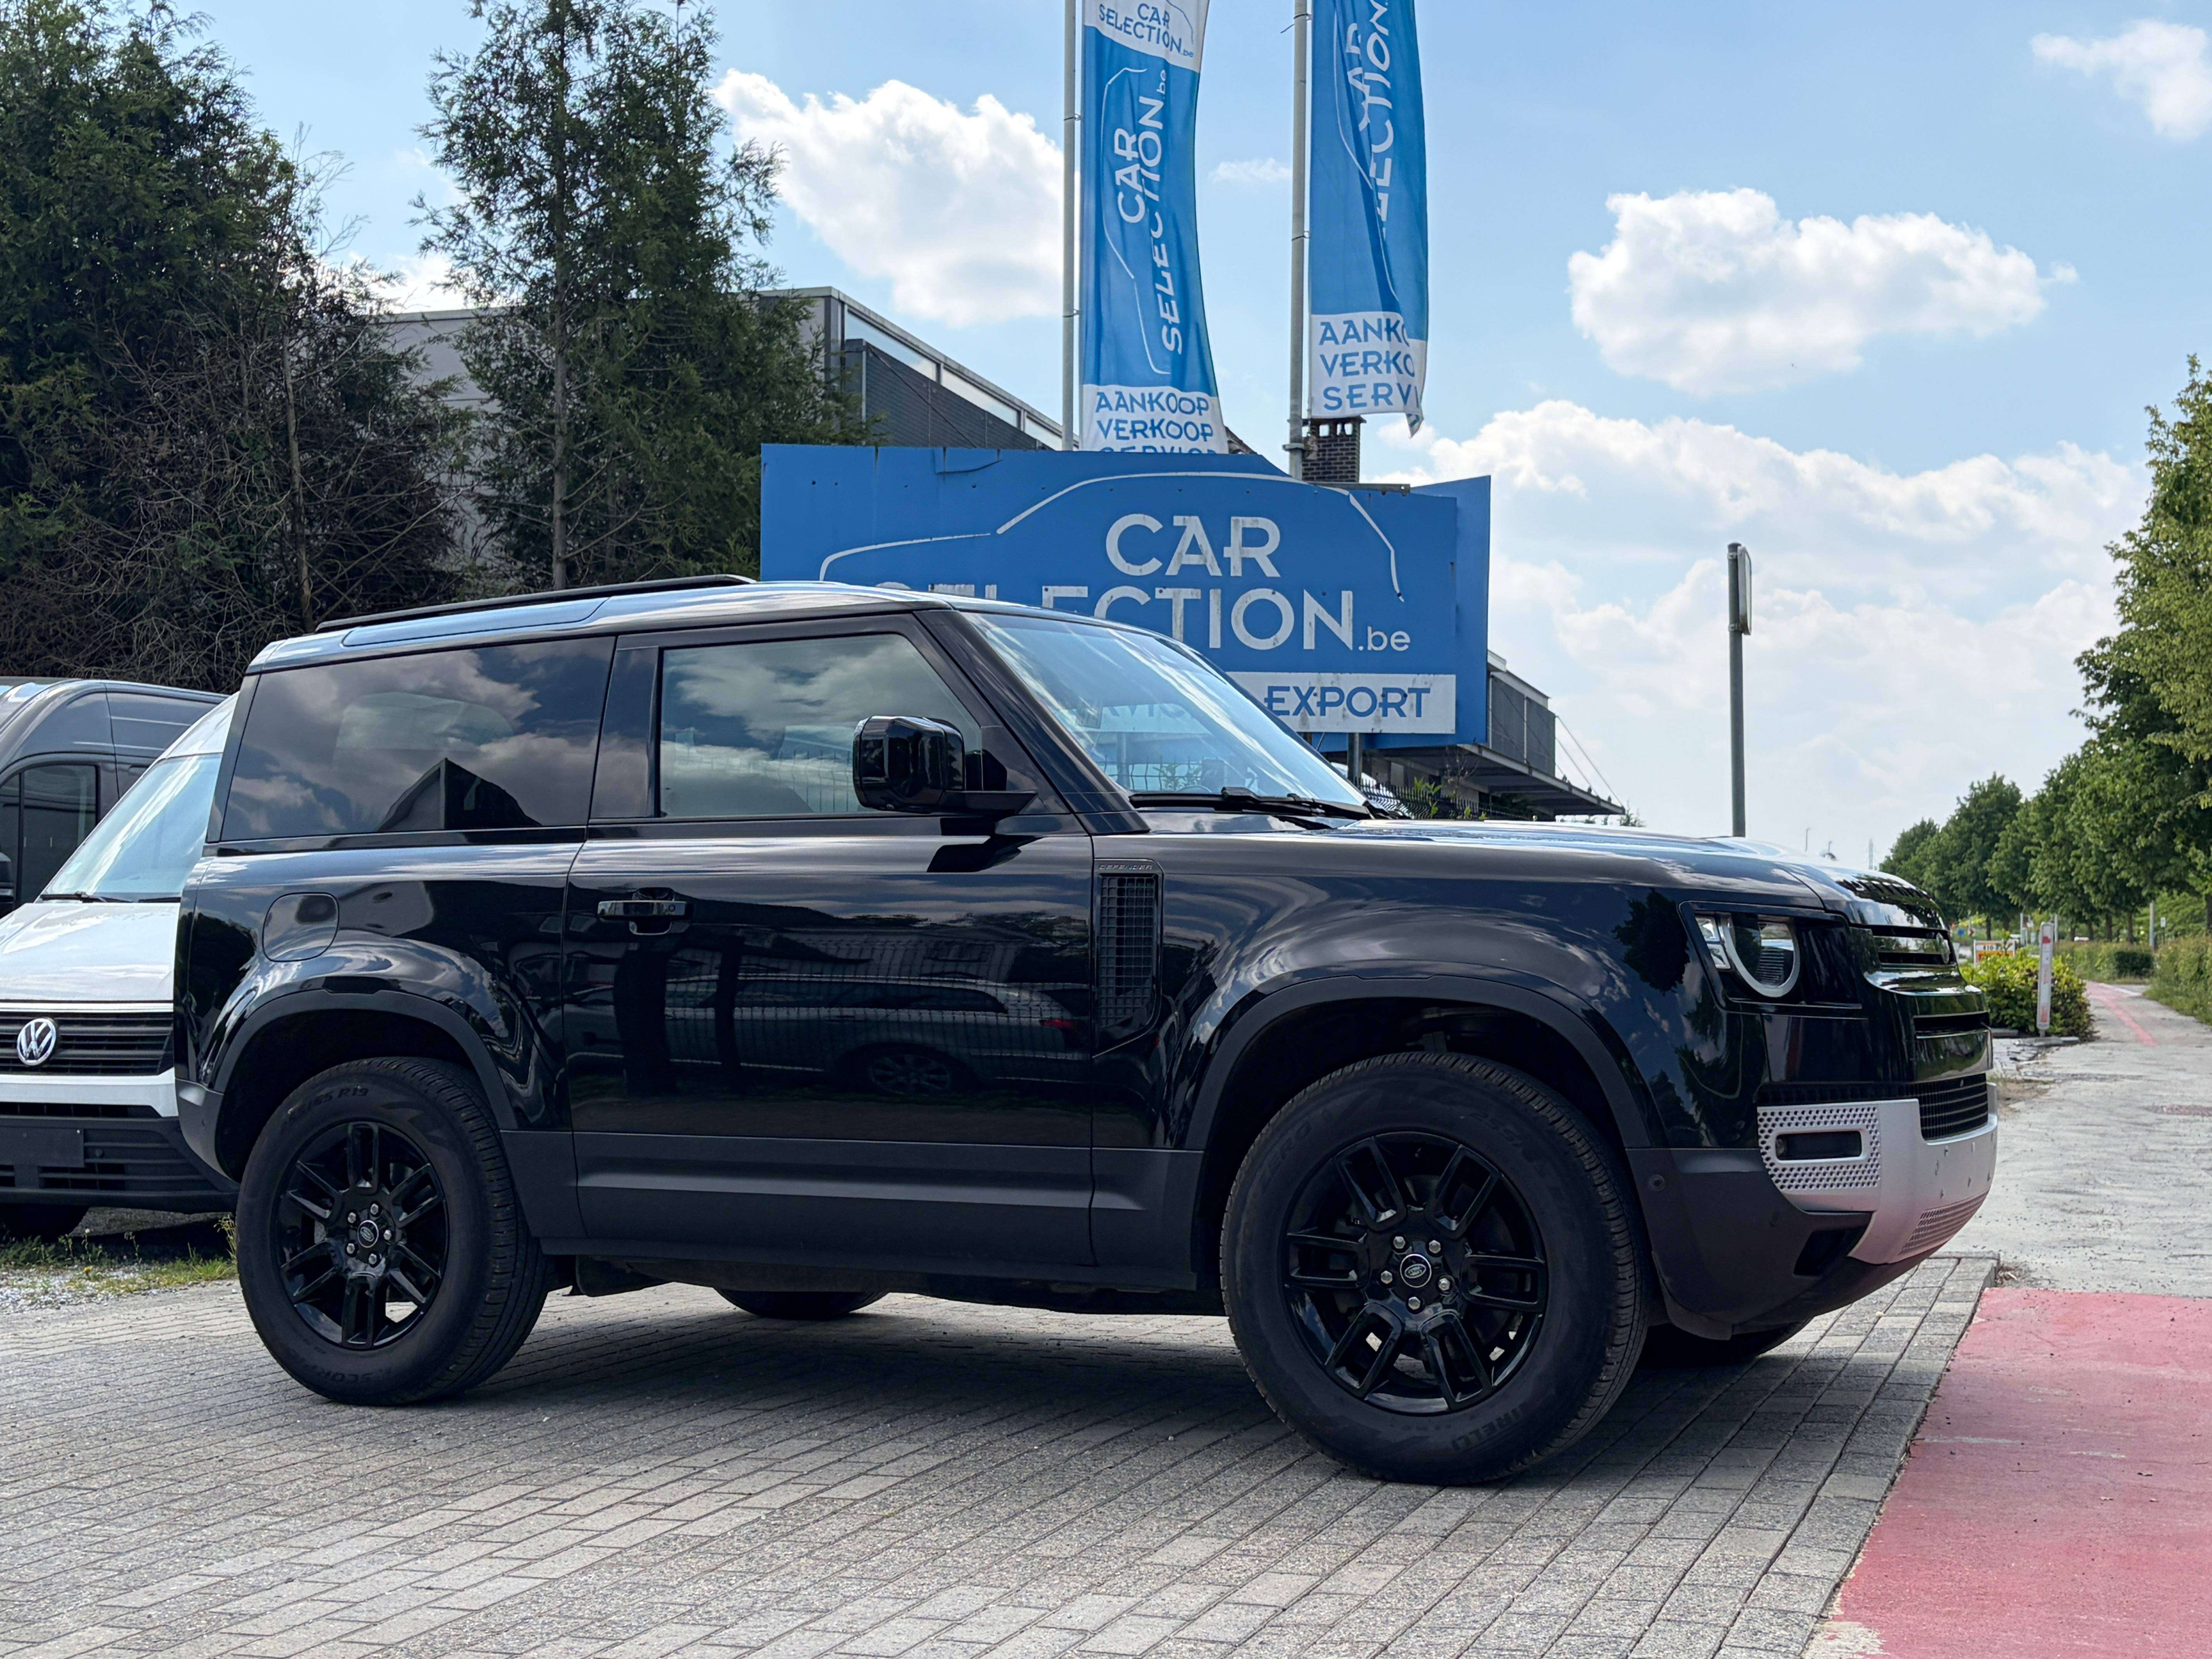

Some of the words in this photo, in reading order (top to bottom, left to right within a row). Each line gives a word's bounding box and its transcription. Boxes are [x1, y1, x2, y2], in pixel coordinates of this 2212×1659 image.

[1099, 3, 1194, 57] SELECTION.be
[1137, 3, 1170, 29] CAR
[1114, 128, 1145, 223] CAR
[1096, 391, 1209, 416] AANKOOP
[1097, 419, 1214, 442] VERKOOP
[1106, 513, 1281, 577] CAR
[1264, 685, 1431, 718] EXPORT
[1451, 1405, 1523, 1451] IRELLI
